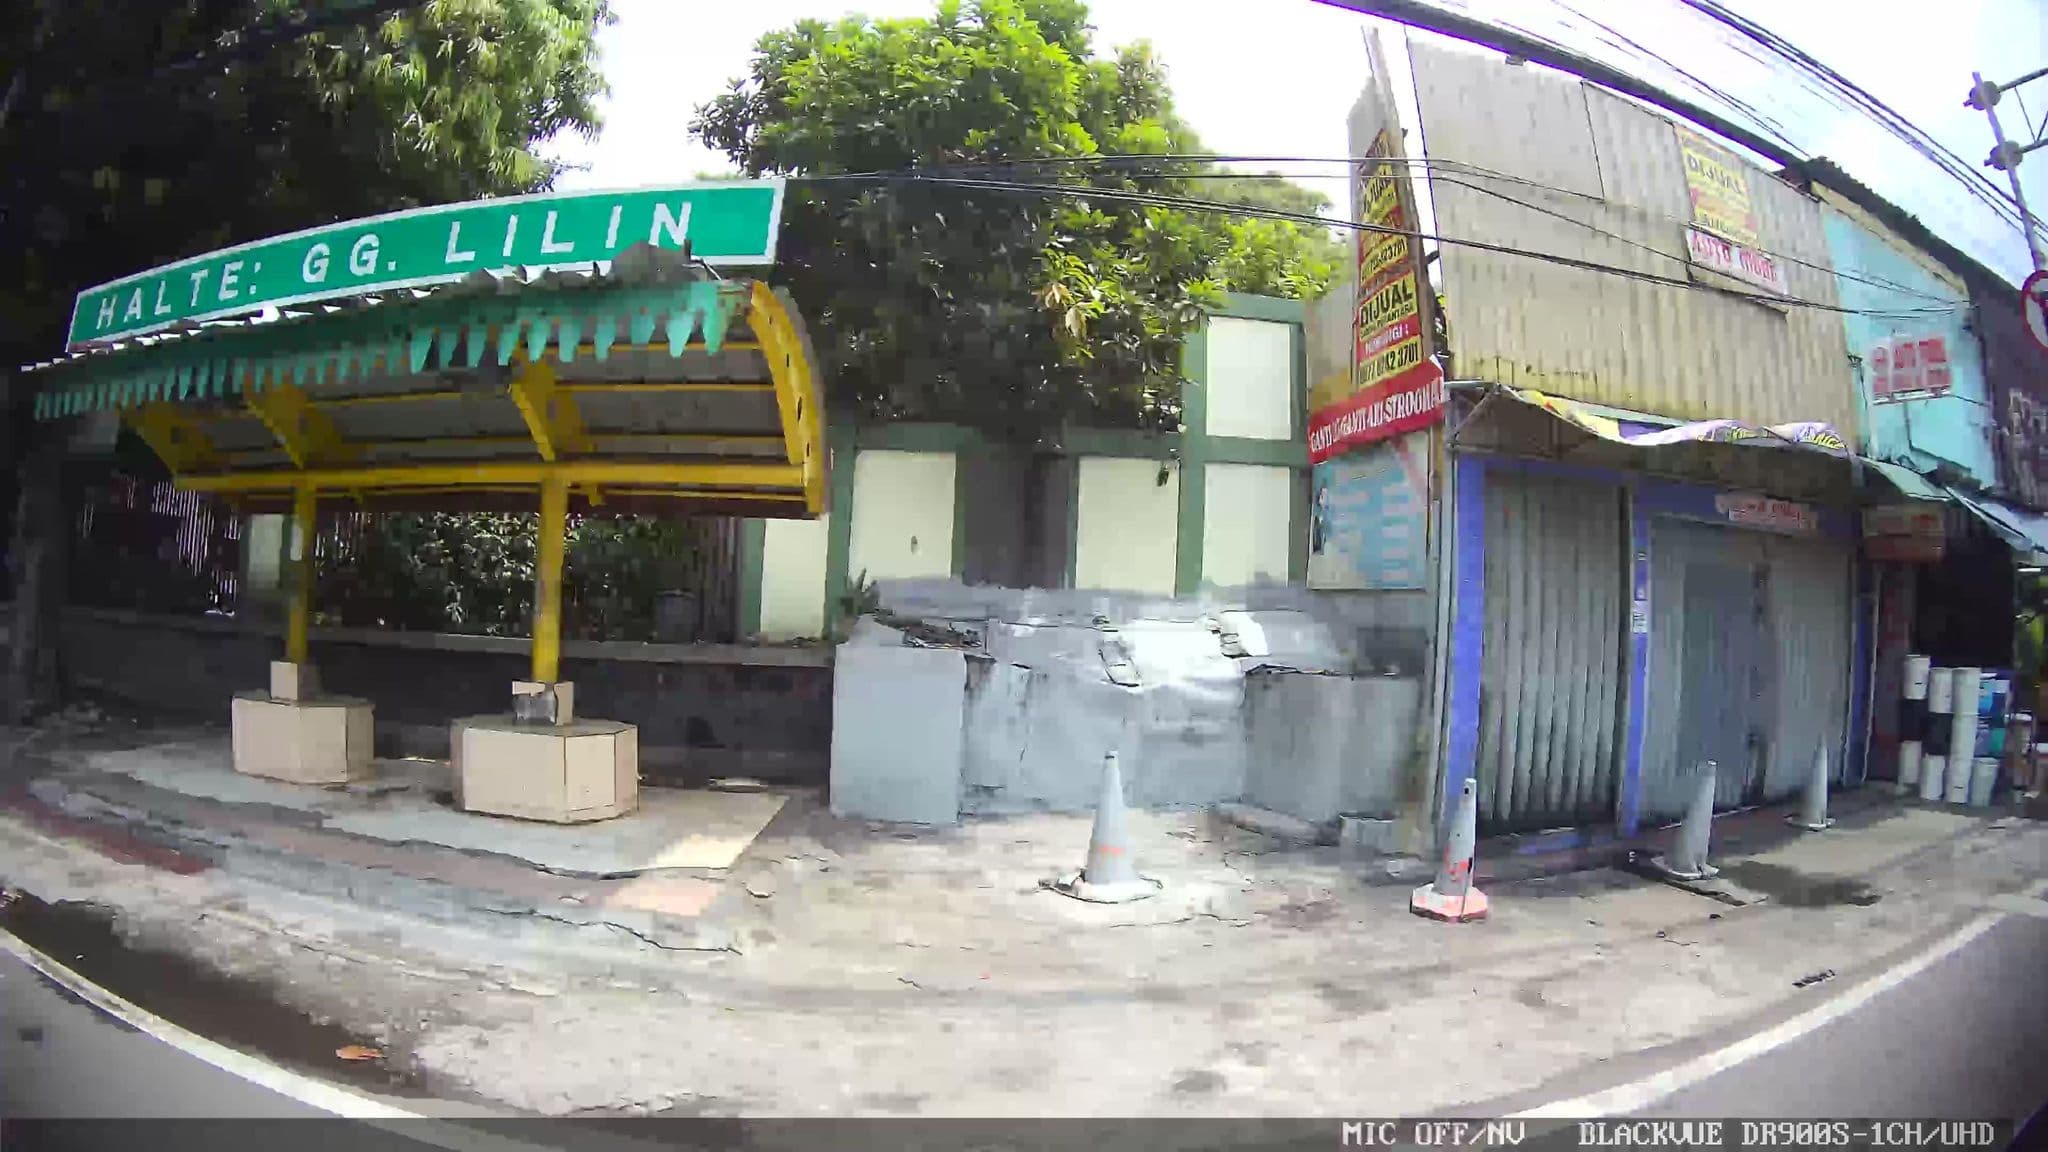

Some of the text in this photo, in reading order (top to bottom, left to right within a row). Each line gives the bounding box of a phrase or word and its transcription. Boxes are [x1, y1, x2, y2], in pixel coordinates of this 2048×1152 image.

[96, 202, 692, 330] HALTE: GG. LILIN
[1360, 279, 1413, 328] DIJUAL
